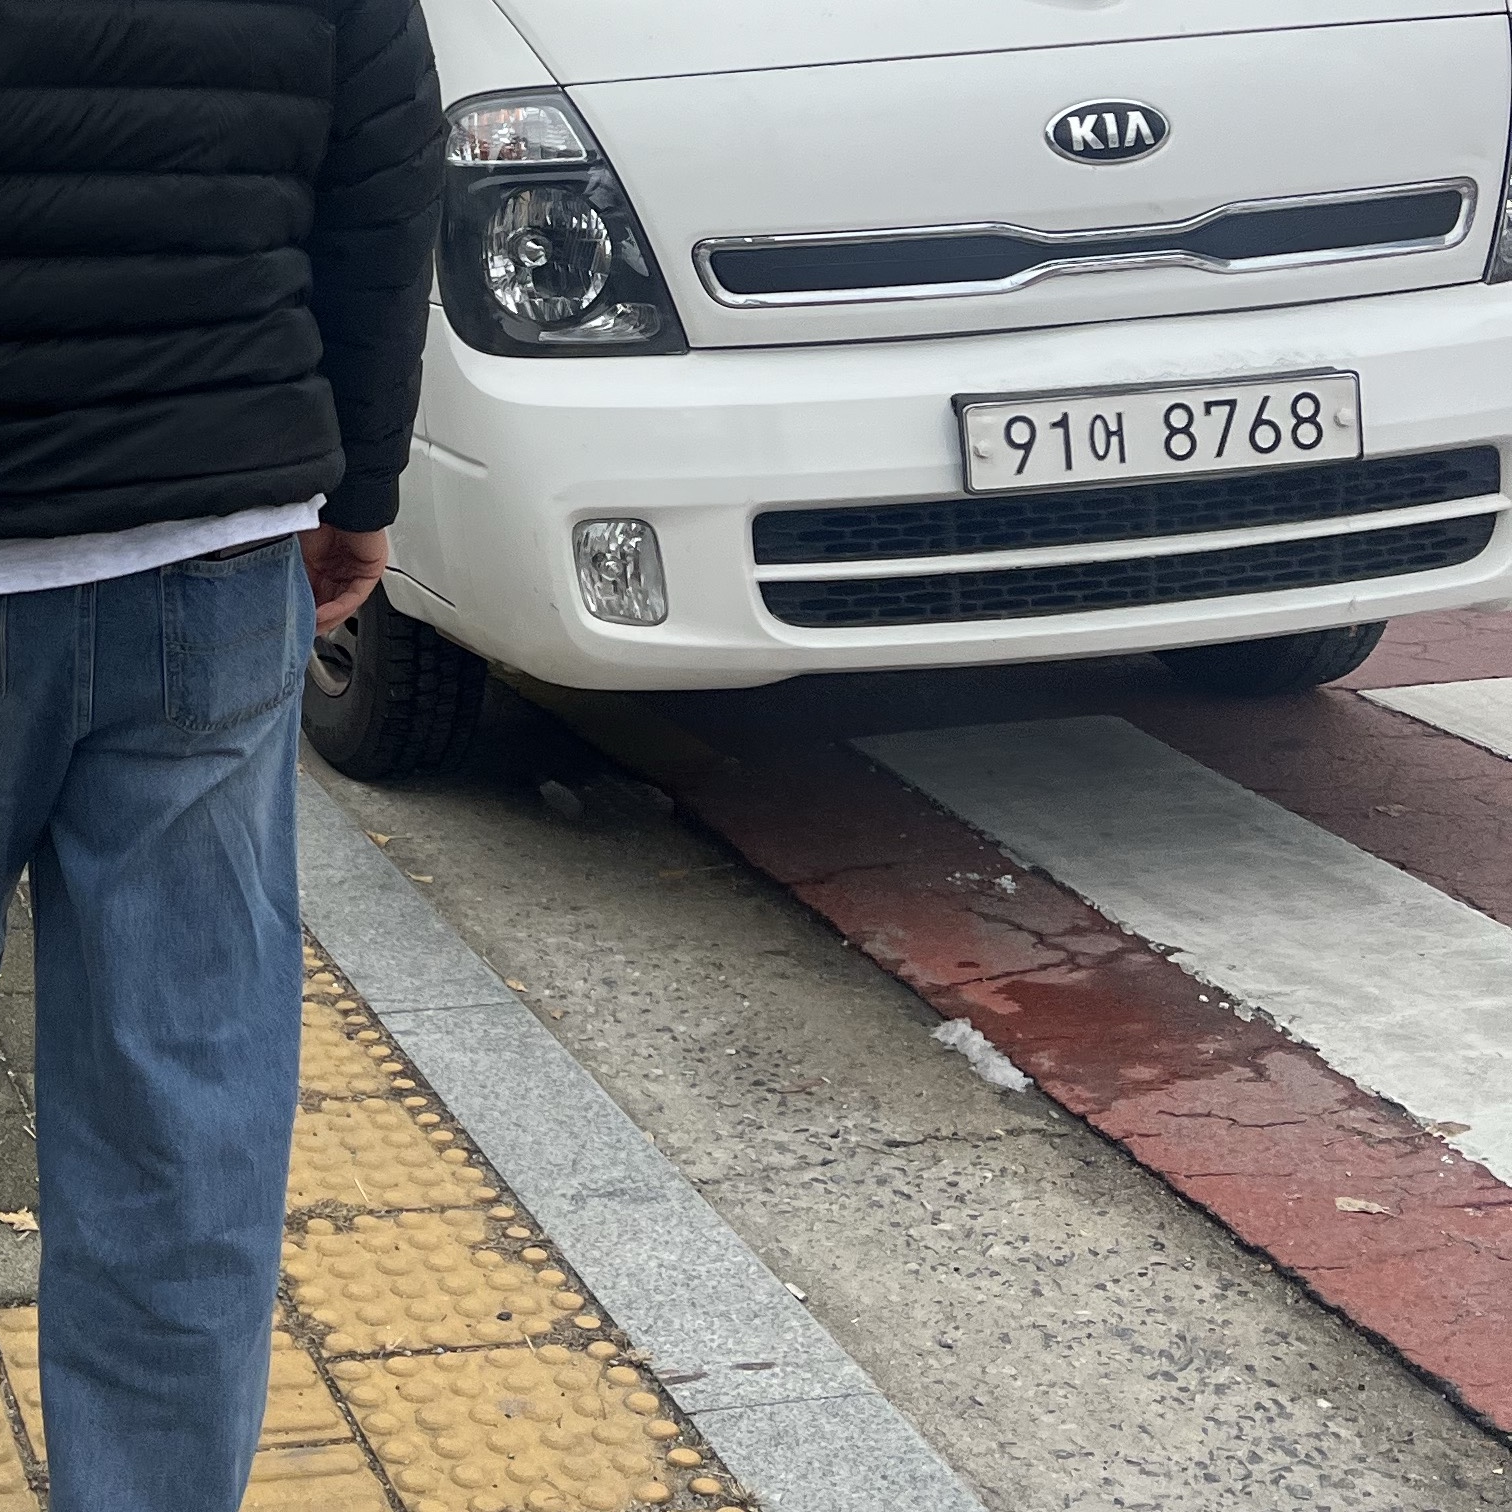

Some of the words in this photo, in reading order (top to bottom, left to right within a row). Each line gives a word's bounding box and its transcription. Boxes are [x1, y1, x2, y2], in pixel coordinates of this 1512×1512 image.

[1067, 110, 1155, 151] KIA
[1003, 412, 1126, 476] 91어
[1163, 391, 1324, 461] 8768
